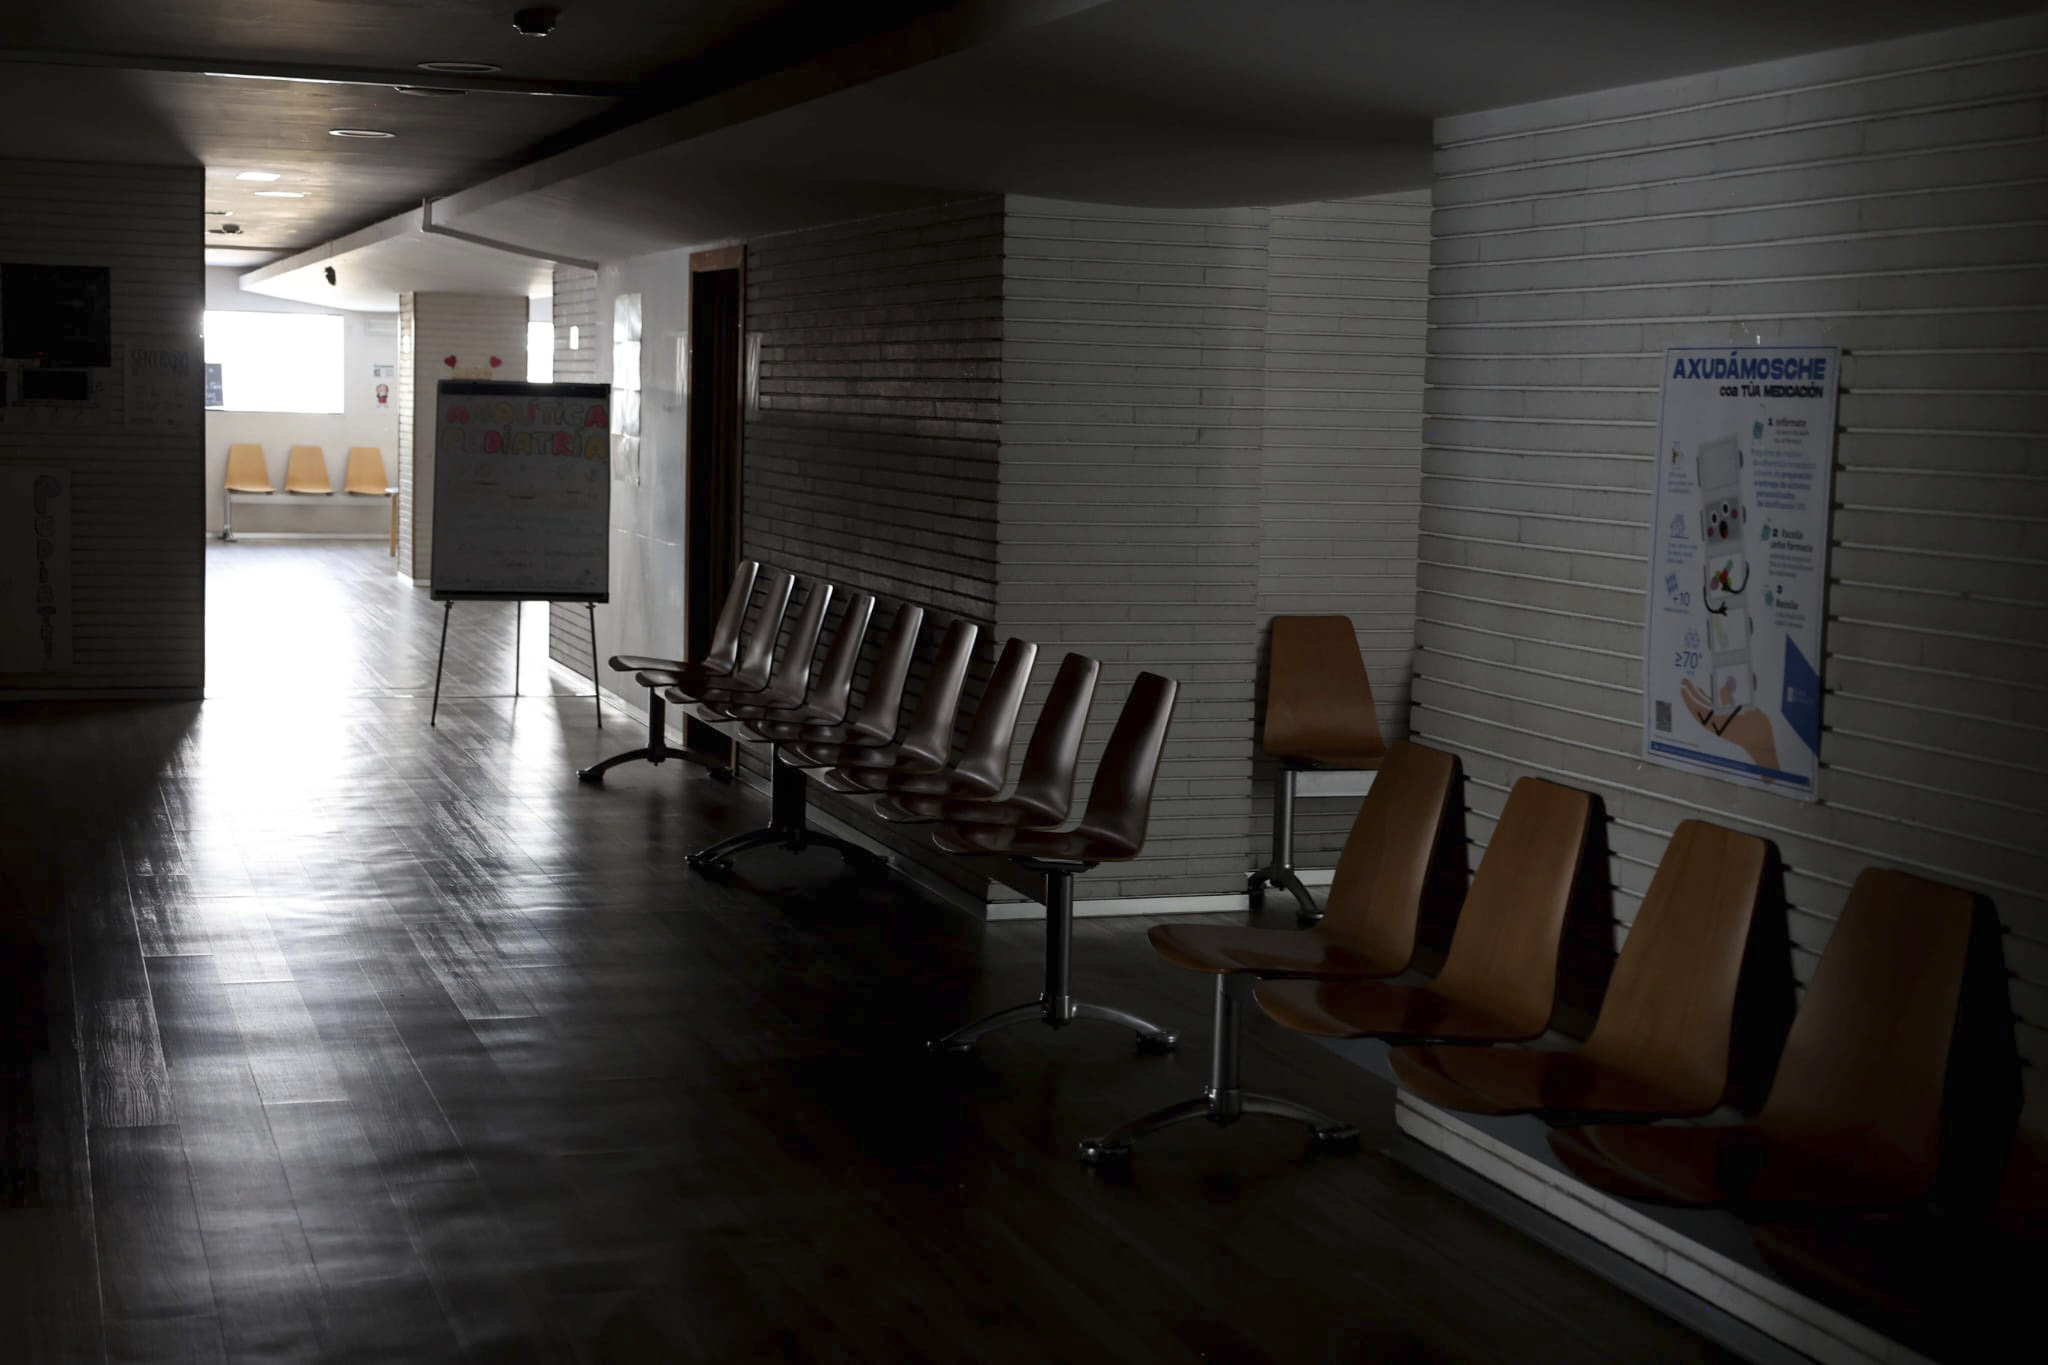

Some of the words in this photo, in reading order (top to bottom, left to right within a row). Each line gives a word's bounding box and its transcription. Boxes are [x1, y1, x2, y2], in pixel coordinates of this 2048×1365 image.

[1673, 352, 1826, 380] AXUDÁMOSCHE
[1719, 386, 1738, 397] coa
[1741, 381, 1761, 397] TÚA
[1763, 381, 1824, 398] MEDICACIÓN
[1673, 592, 1690, 608] +10
